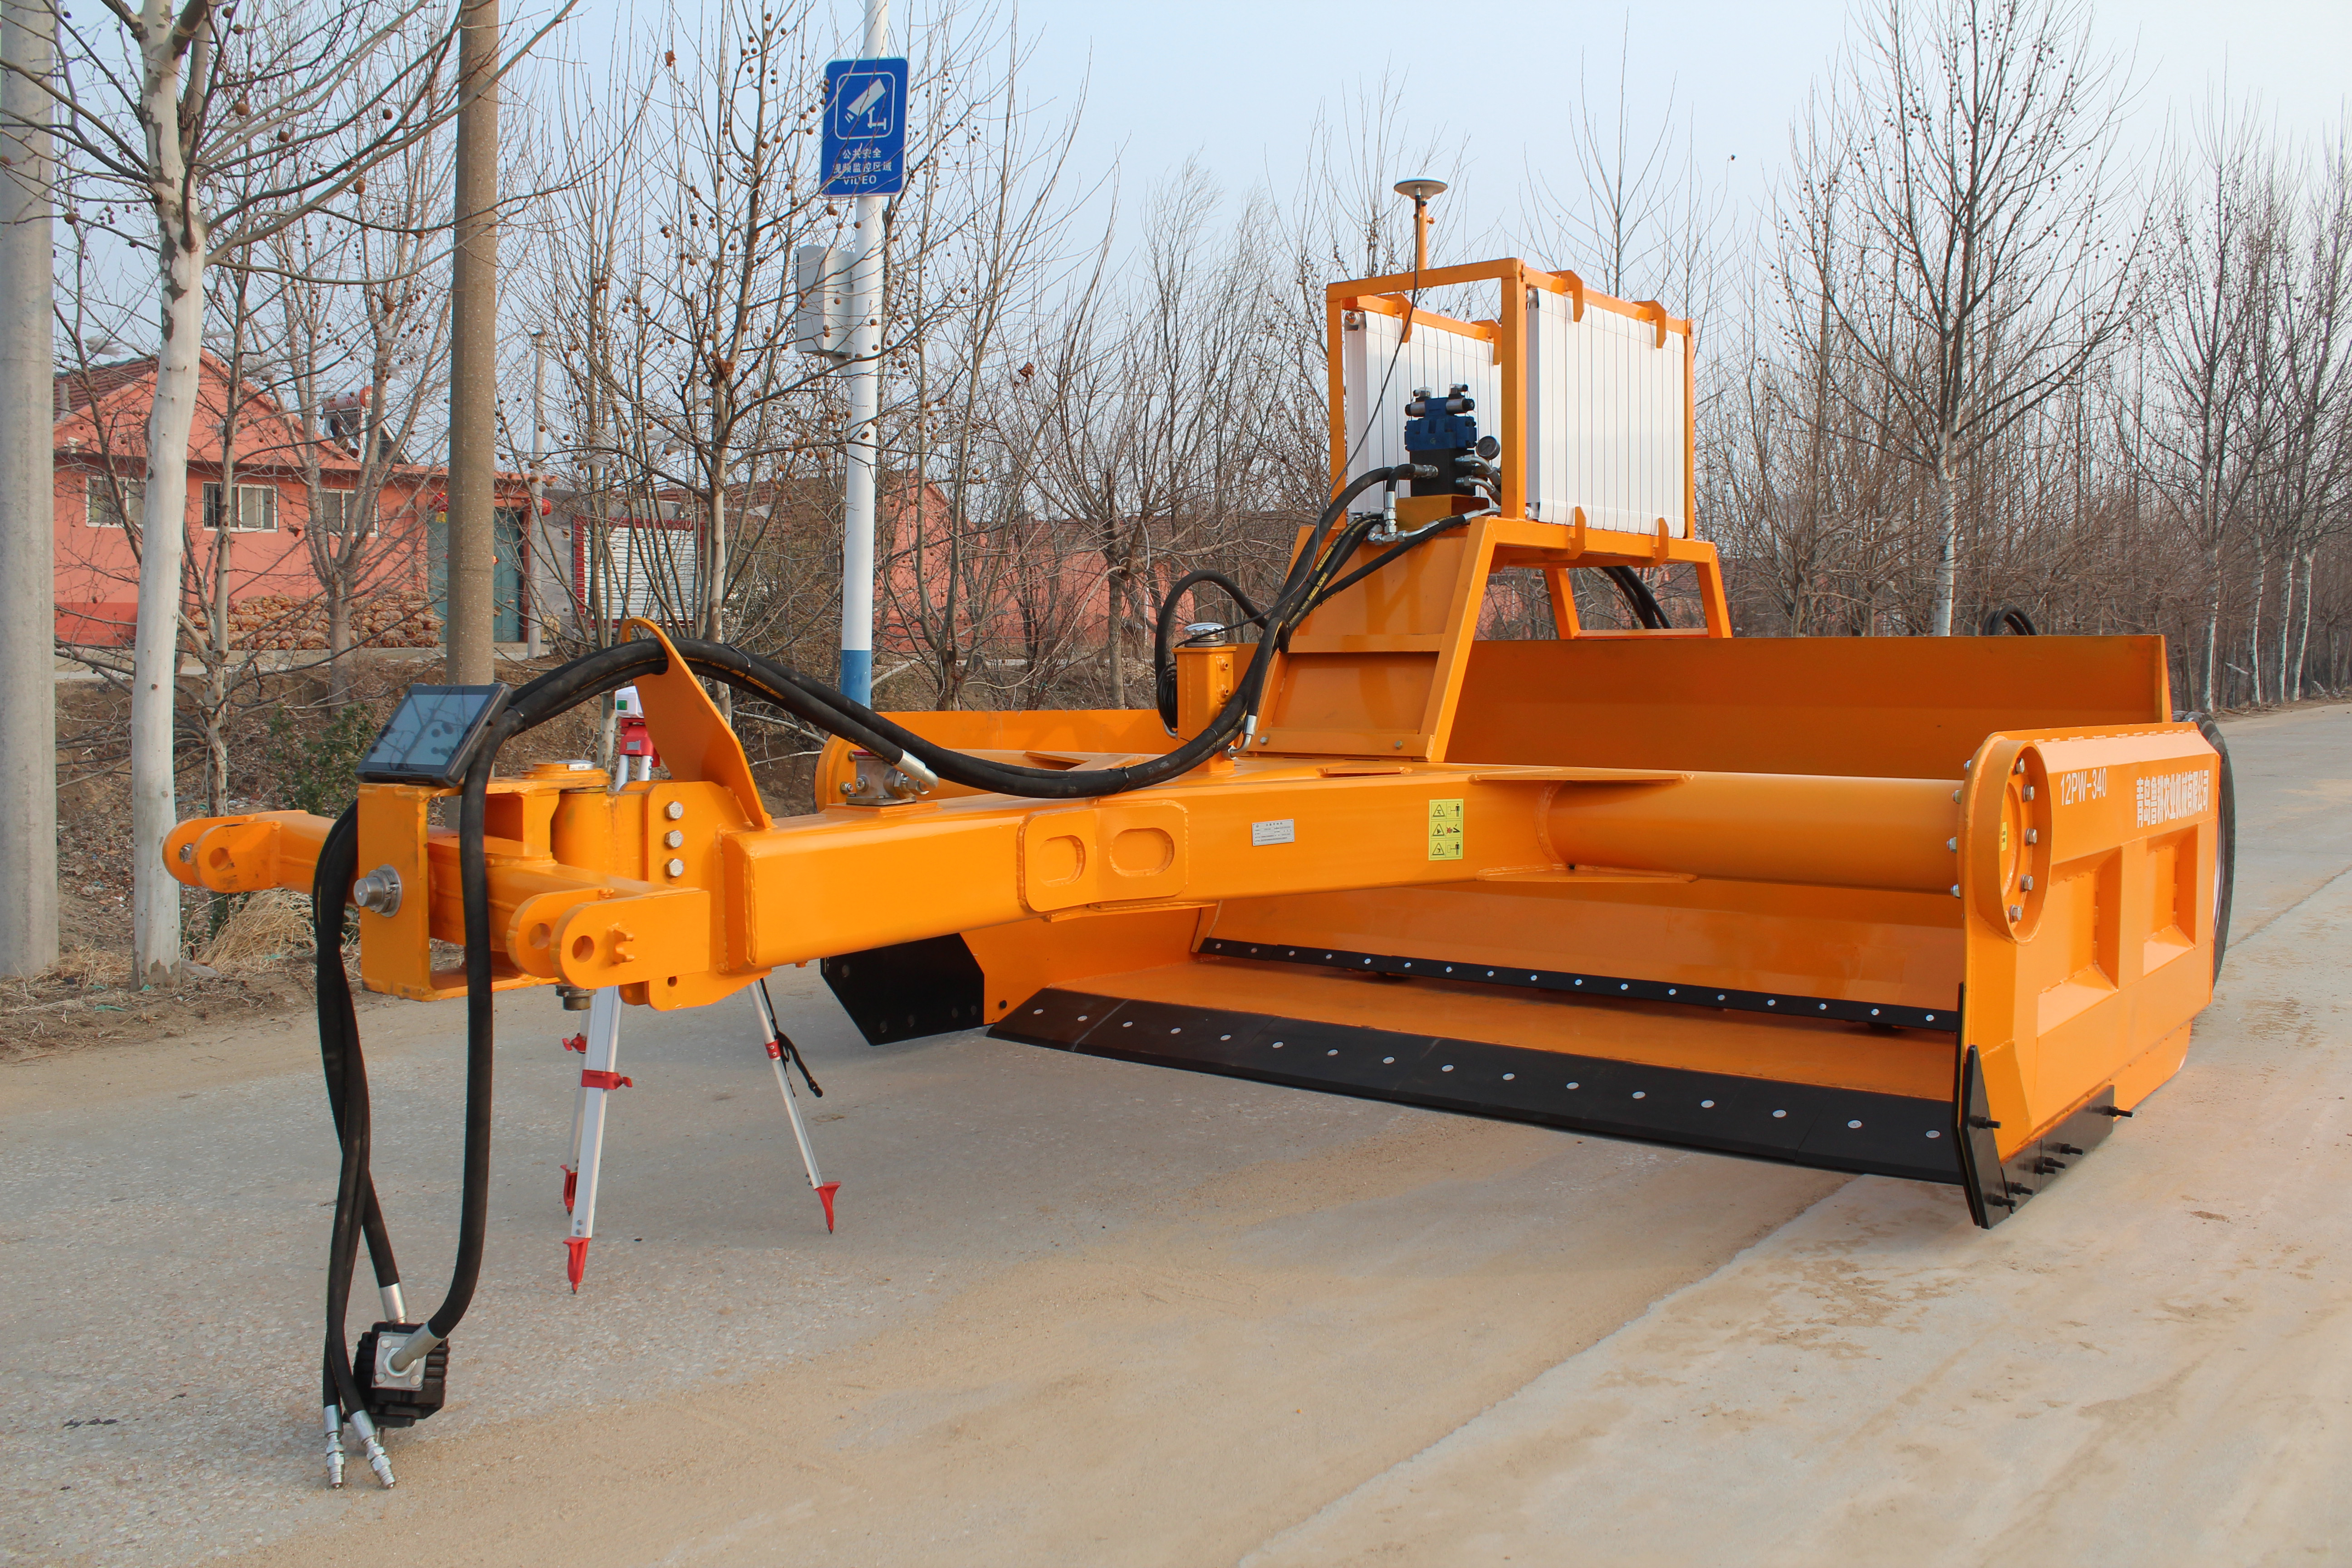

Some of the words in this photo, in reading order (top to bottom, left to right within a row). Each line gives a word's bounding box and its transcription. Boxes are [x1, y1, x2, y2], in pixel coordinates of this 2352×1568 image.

[843, 147, 882, 159] 公共安全
[833, 162, 892, 174] 视频监控区域
[843, 175, 877, 185] VIDEO
[2060, 767, 2107, 806] 12PW-340
[2136, 769, 2209, 828] 青岛鲁耕农业机械有限公司
